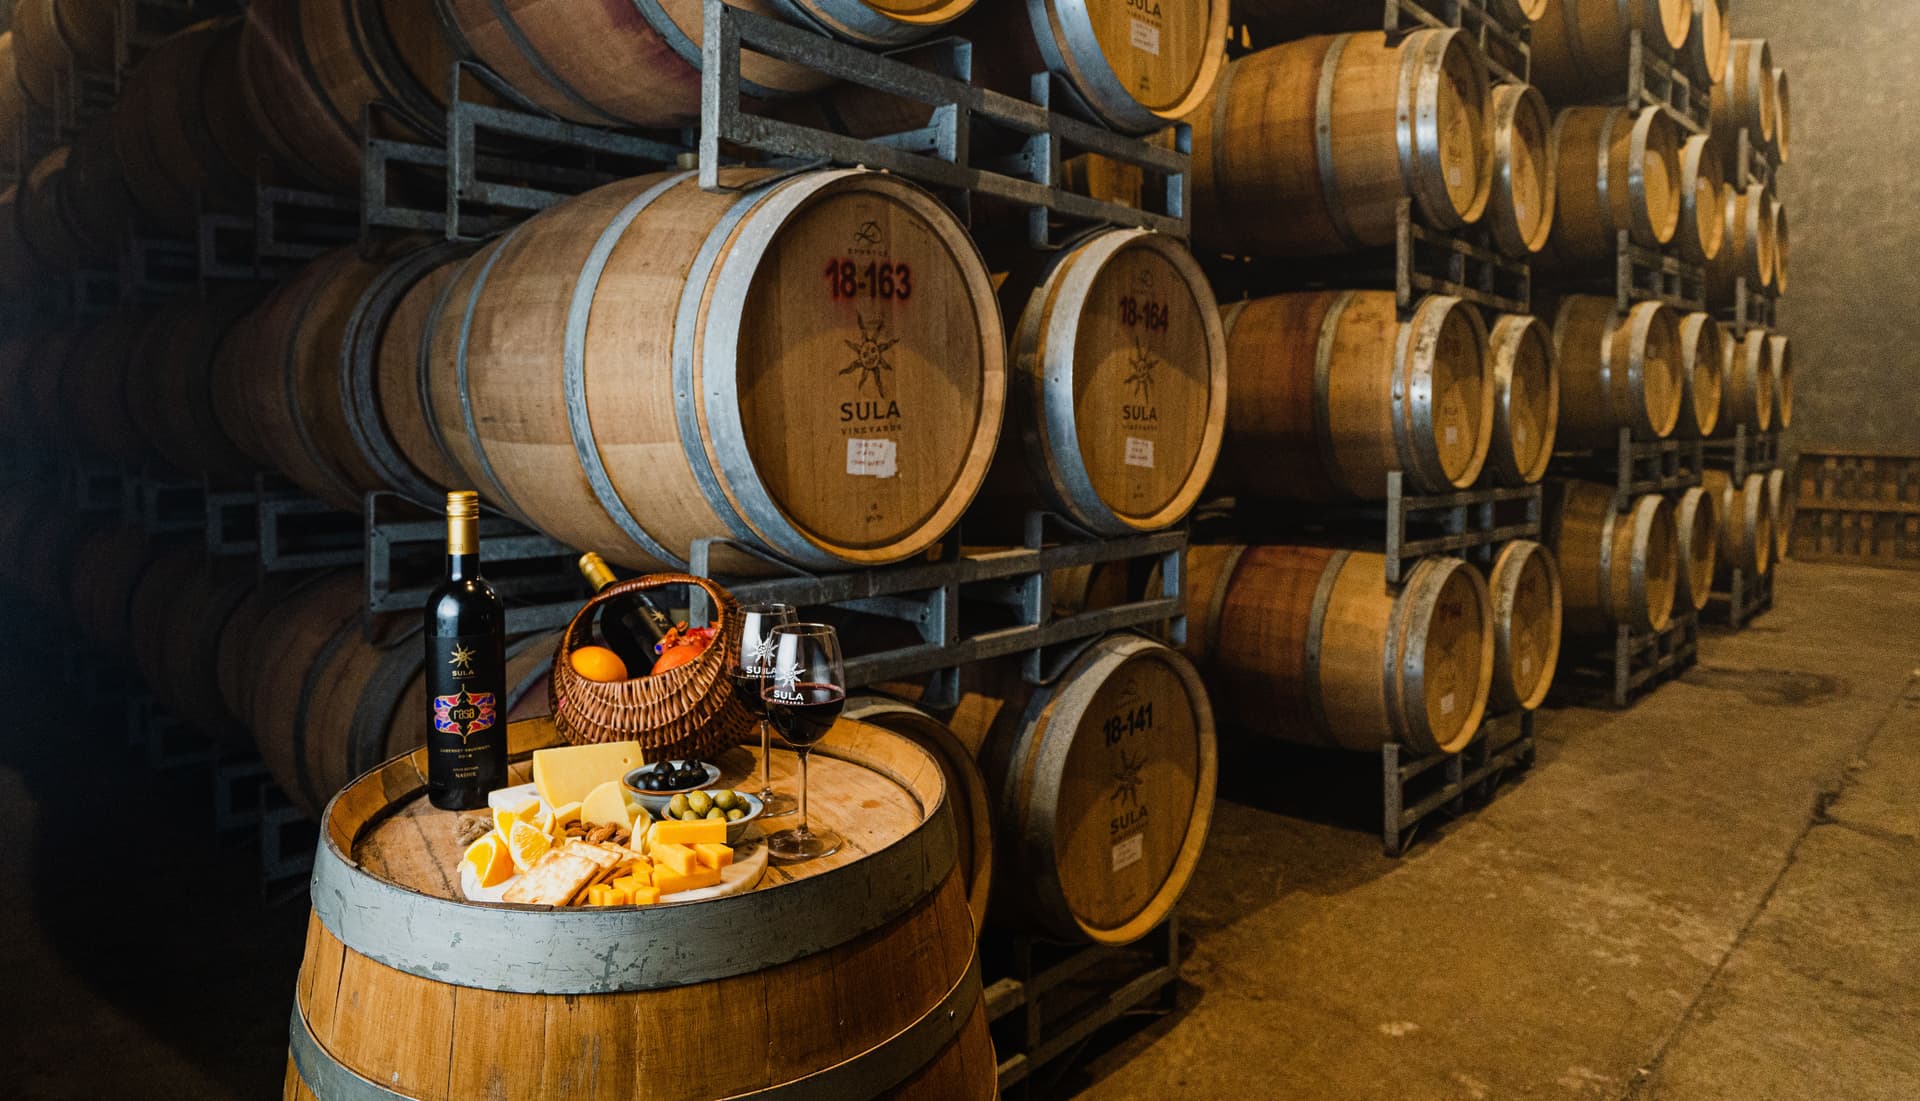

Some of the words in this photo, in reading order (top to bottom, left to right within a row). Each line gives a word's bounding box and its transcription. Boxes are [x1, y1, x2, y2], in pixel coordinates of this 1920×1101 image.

[824, 259, 912, 300] 18-163
[1120, 296, 1169, 333] 18-164
[840, 400, 901, 421] SULA
[1122, 405, 1158, 421] SULA
[841, 424, 902, 435] VINEYARDS
[773, 690, 804, 701] SULA
[1103, 702, 1153, 747] 18-141
[1110, 805, 1148, 834] SULA
